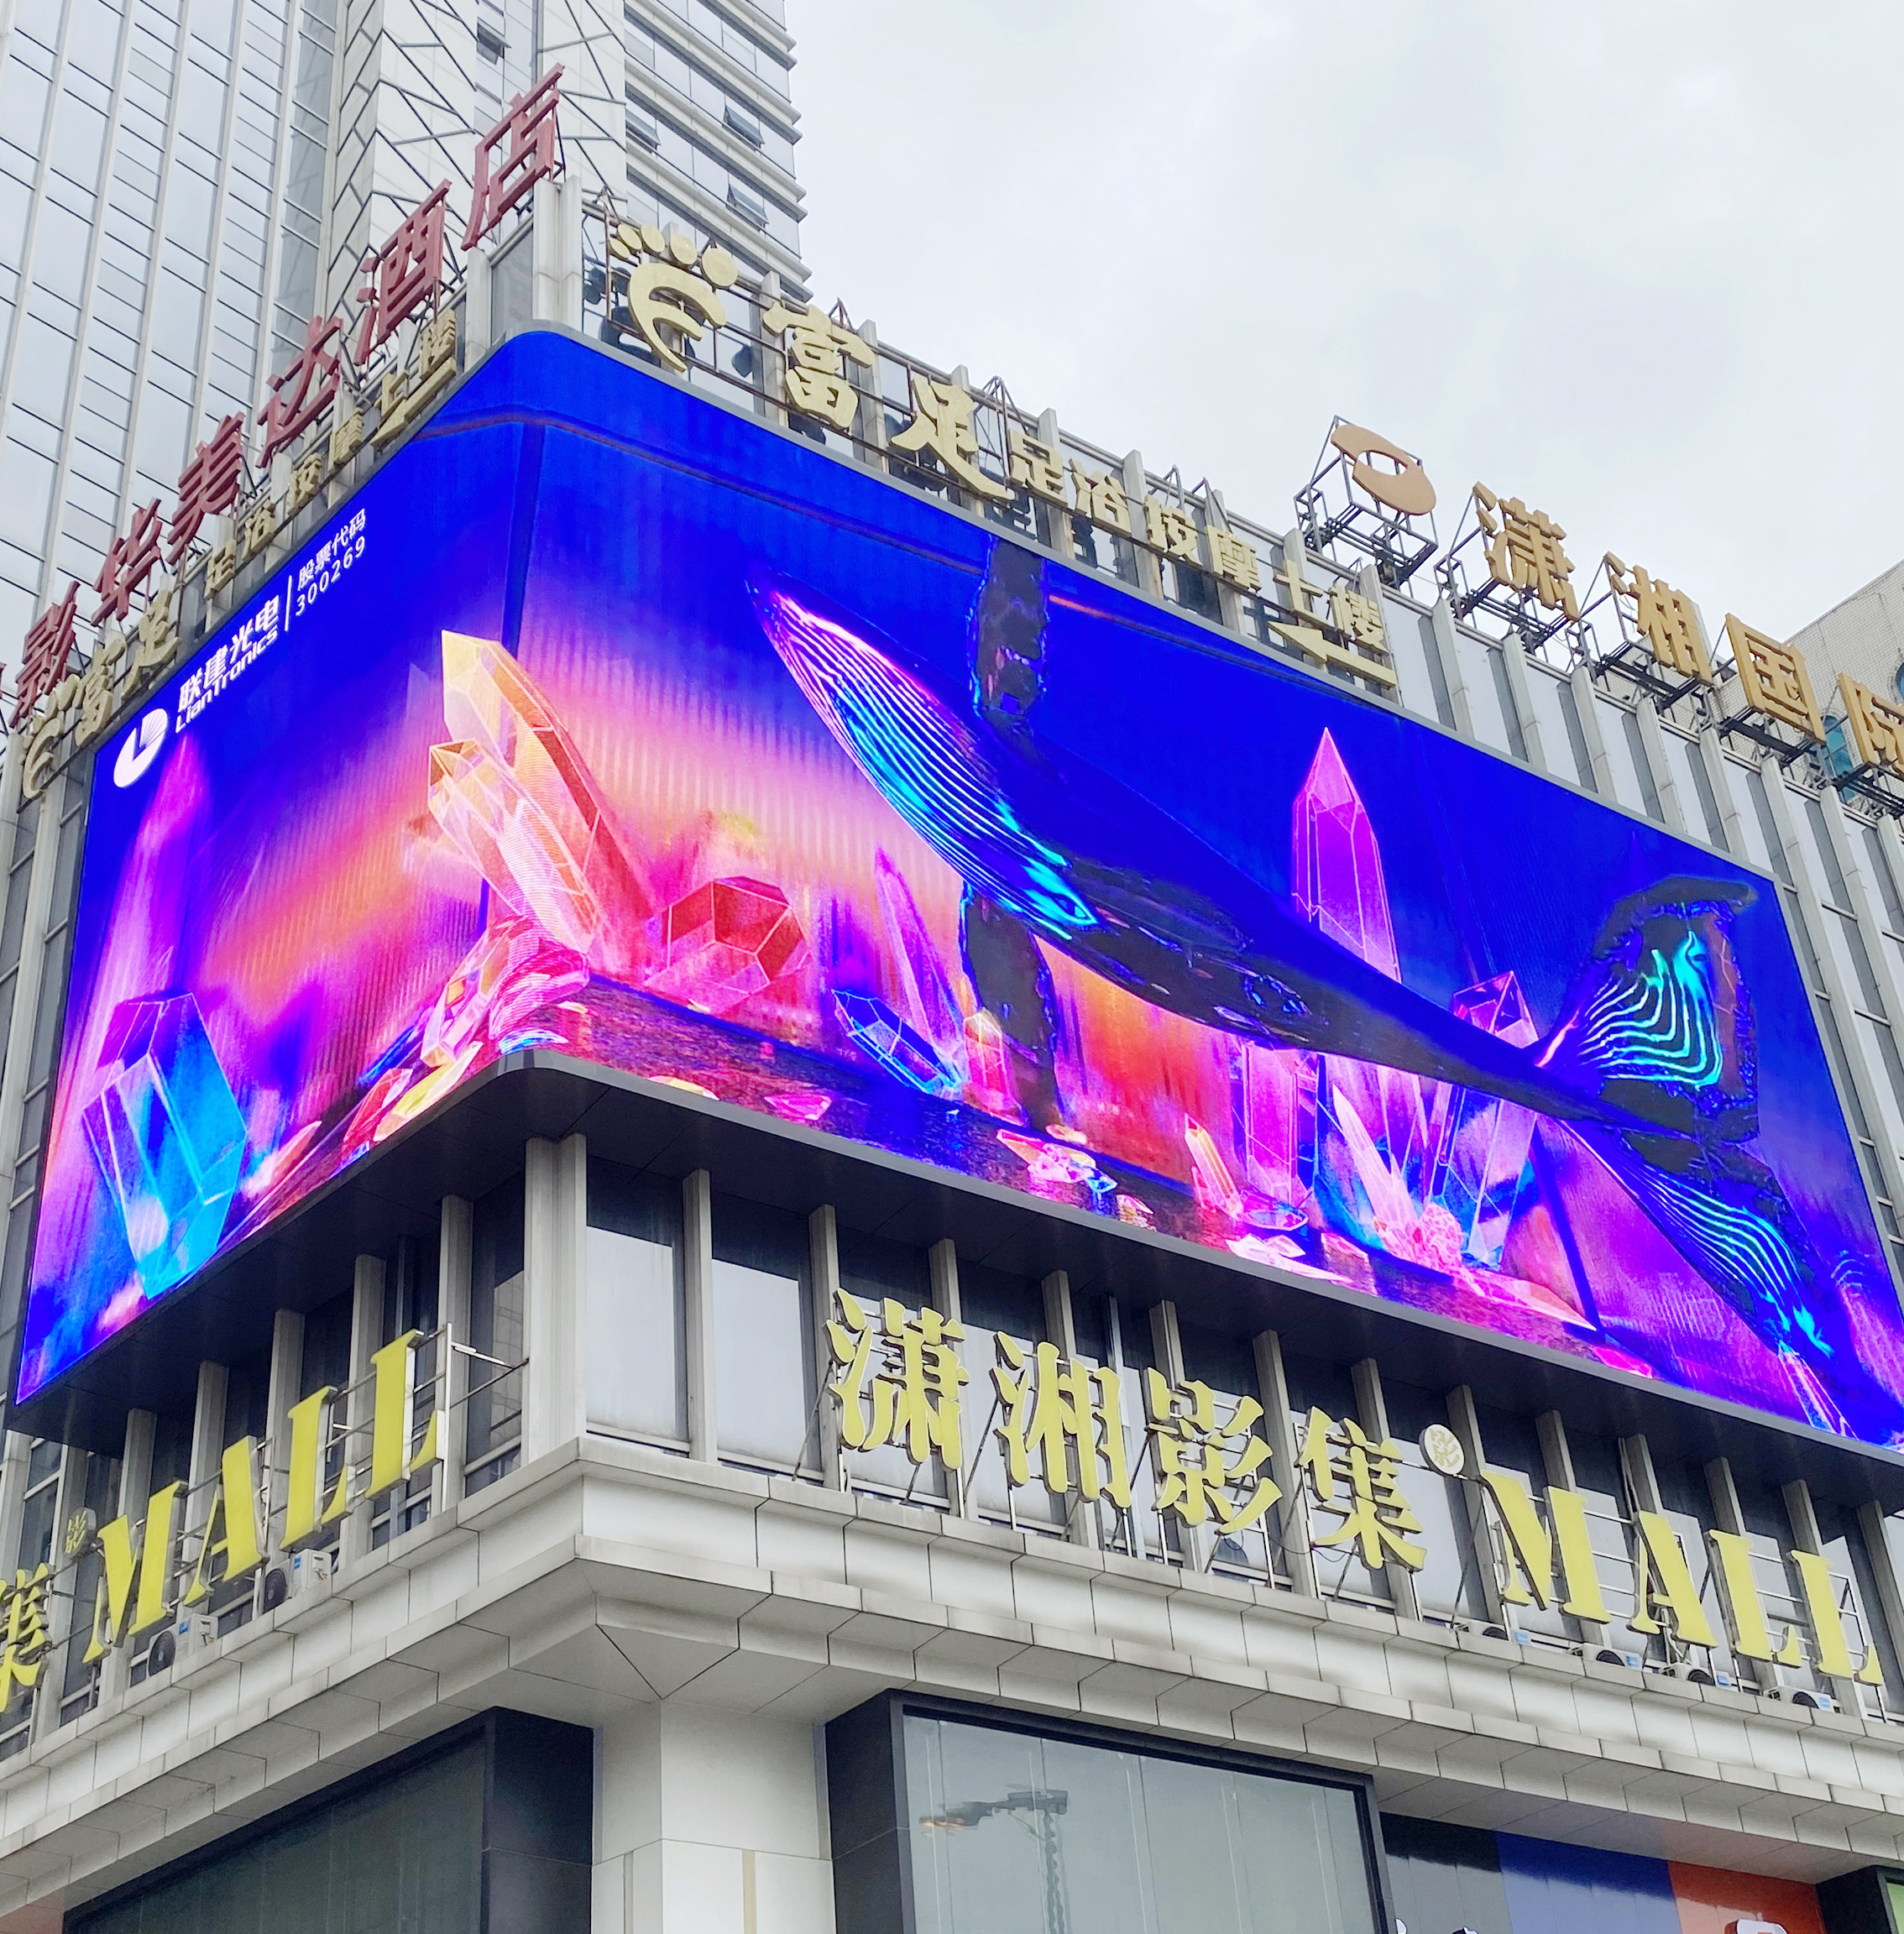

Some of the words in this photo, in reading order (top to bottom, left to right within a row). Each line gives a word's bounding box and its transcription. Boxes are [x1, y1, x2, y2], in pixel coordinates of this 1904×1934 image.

[0, 65, 563, 729] 影华美达酒店
[177, 595, 280, 713] 联建光电
[295, 536, 365, 616] 300269
[297, 508, 365, 591] 股票代码
[82, 1330, 445, 1664] MALL
[827, 1288, 1425, 1571] 潇湘影集
[1479, 1469, 1884, 1686] MALL
